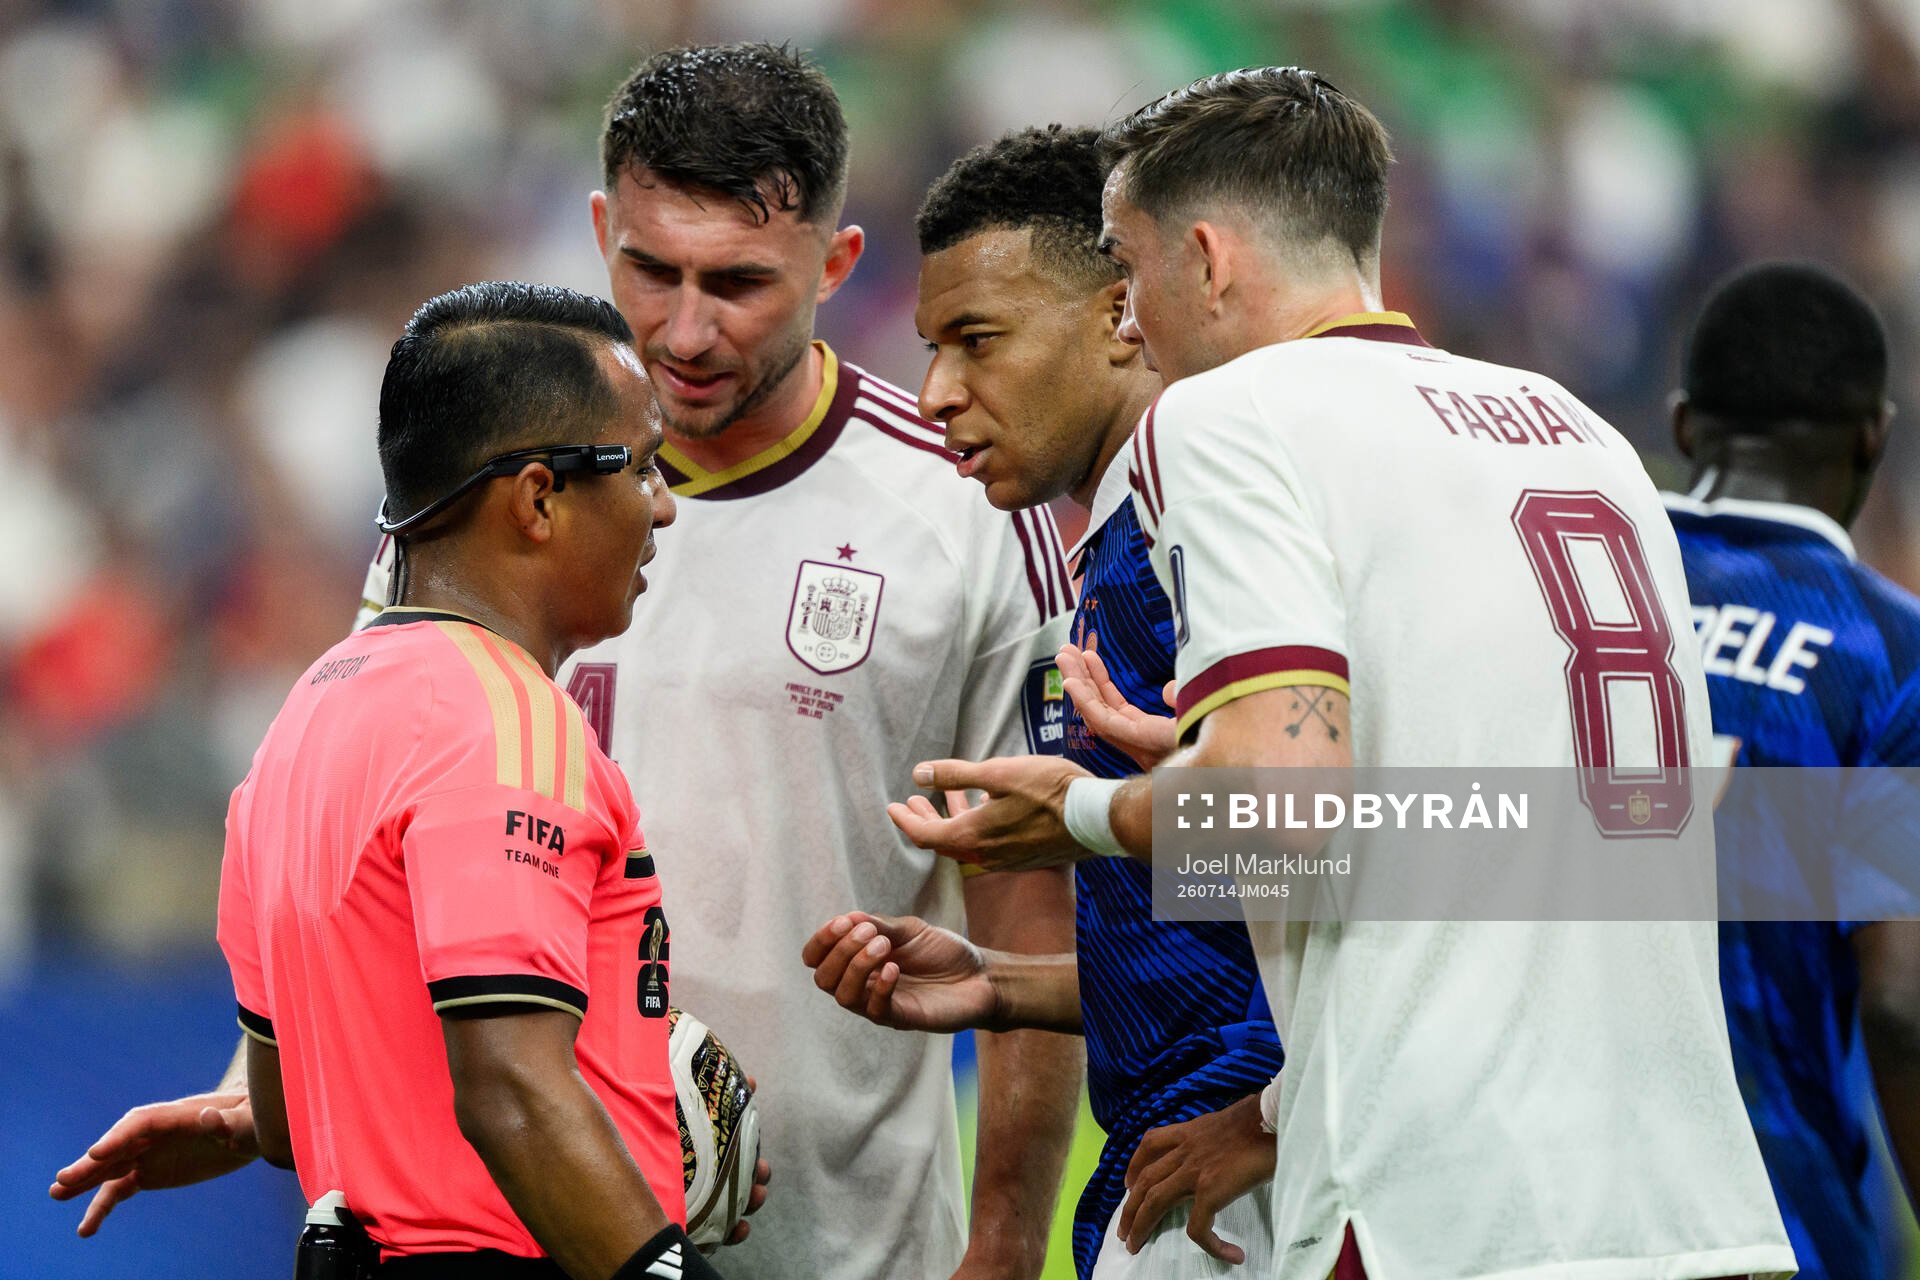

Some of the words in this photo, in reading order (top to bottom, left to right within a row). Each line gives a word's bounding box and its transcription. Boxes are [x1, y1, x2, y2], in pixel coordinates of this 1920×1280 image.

[596, 453, 624, 461] Lenovo
[311, 655, 370, 685] BARTON
[1511, 489, 1694, 839] 8
[506, 810, 565, 856] FIFA
[505, 849, 540, 871] TEAM
[542, 861, 560, 879] ONE
[645, 996, 661, 1009] FIFA
